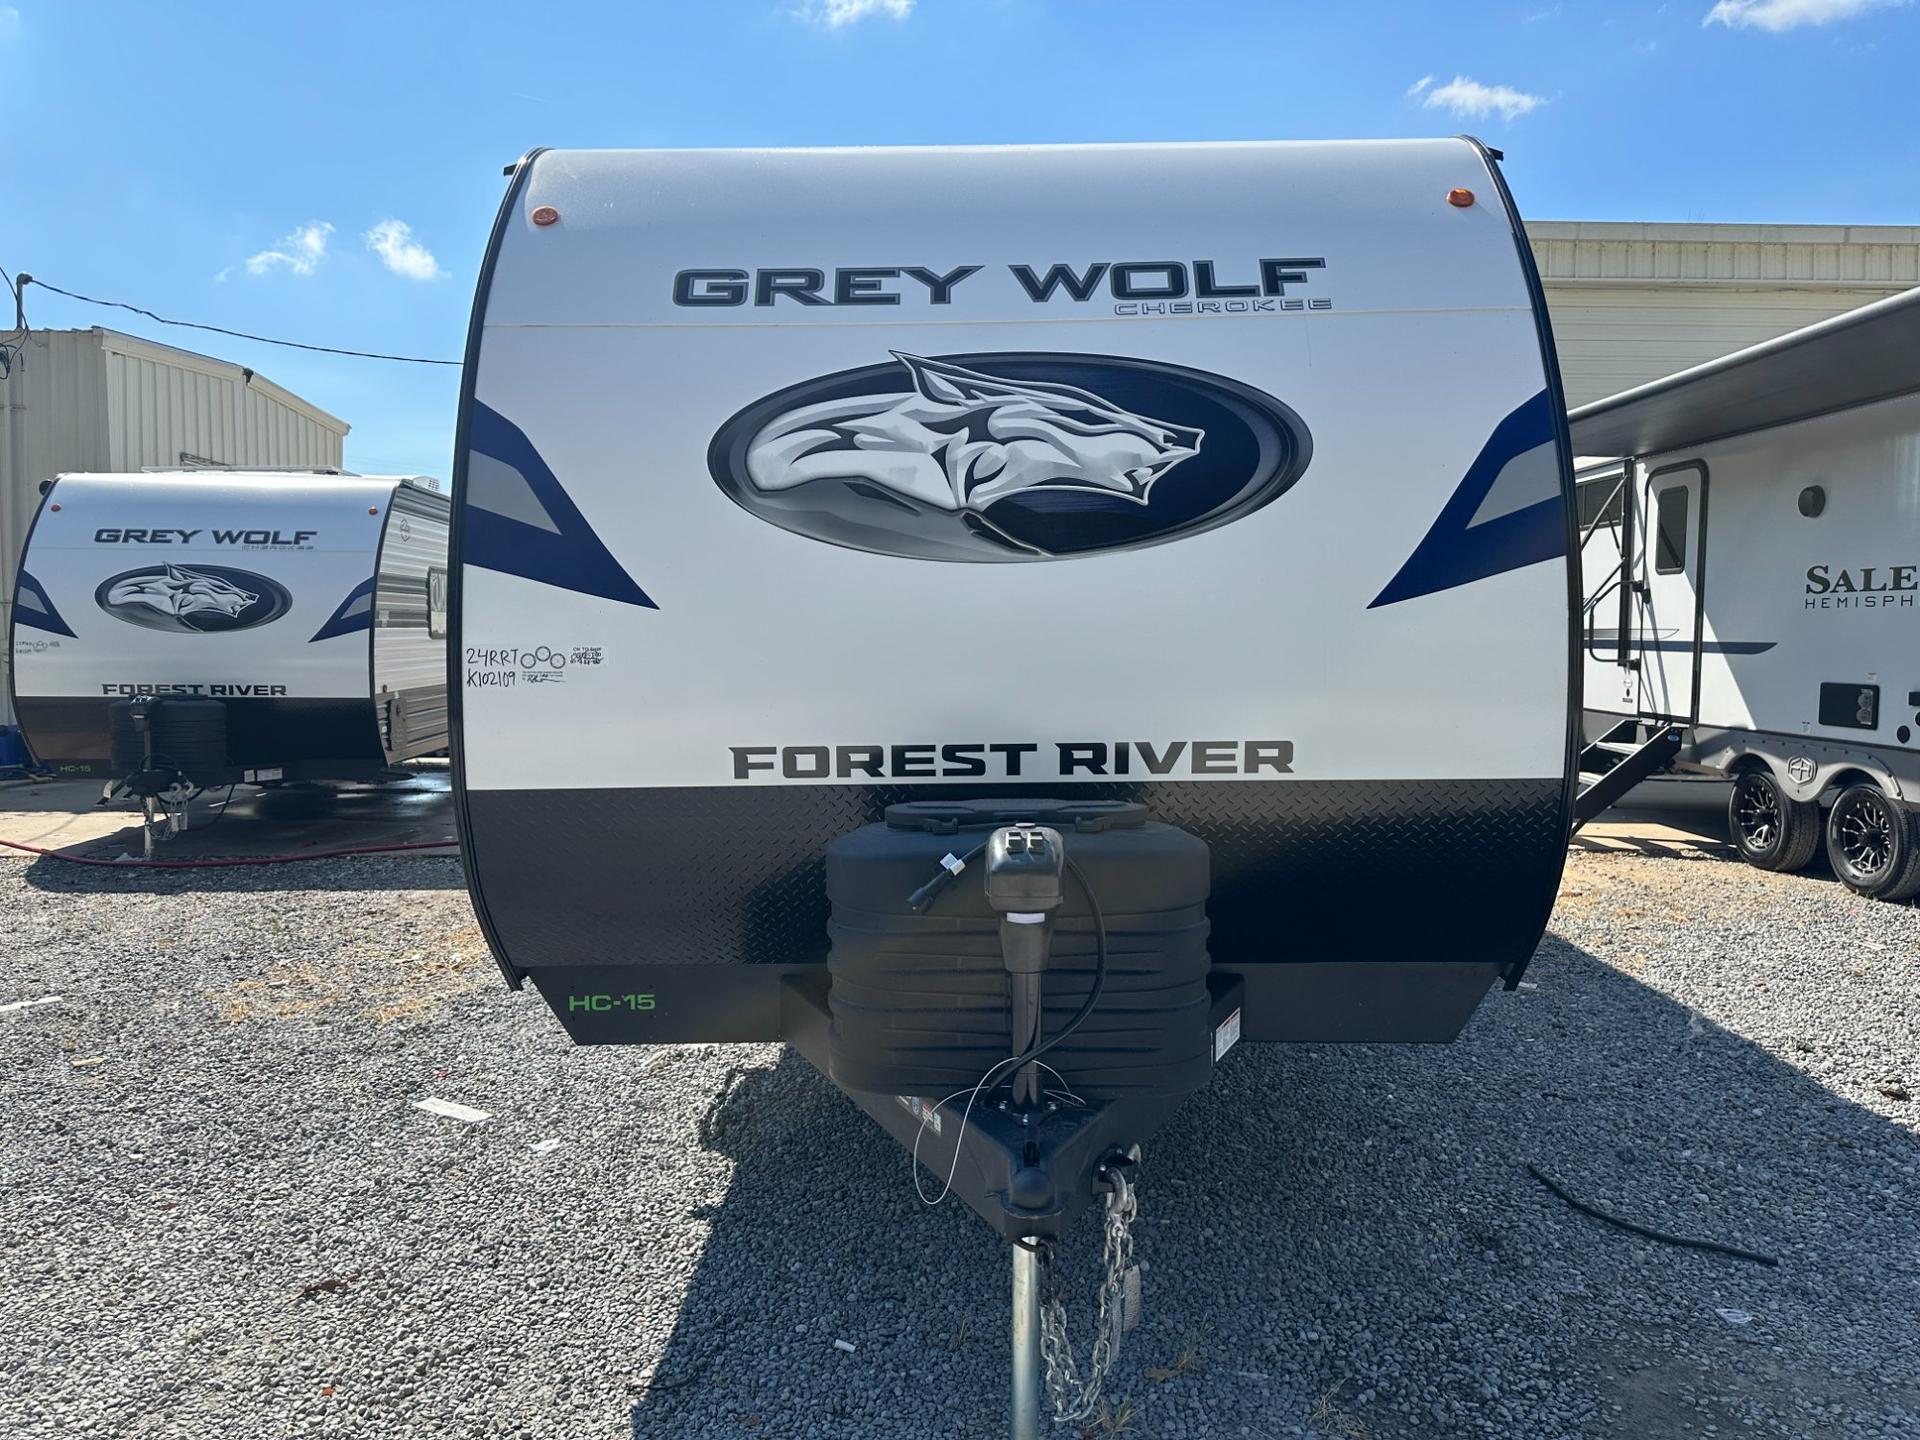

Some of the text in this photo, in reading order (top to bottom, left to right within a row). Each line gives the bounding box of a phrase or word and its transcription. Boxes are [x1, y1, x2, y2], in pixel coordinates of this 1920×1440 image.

[673, 257, 1326, 307] GREY WOLF
[1114, 298, 1332, 315] CHEROKEE
[94, 528, 318, 545] GREY WOLF
[1805, 565, 1918, 595] SALE
[466, 648, 519, 666] 24RRT
[466, 670, 516, 688] K102109
[102, 684, 288, 696] FOREST RIVER
[728, 740, 1294, 779] FOREST RIVER
[568, 994, 656, 1011] HC-15
